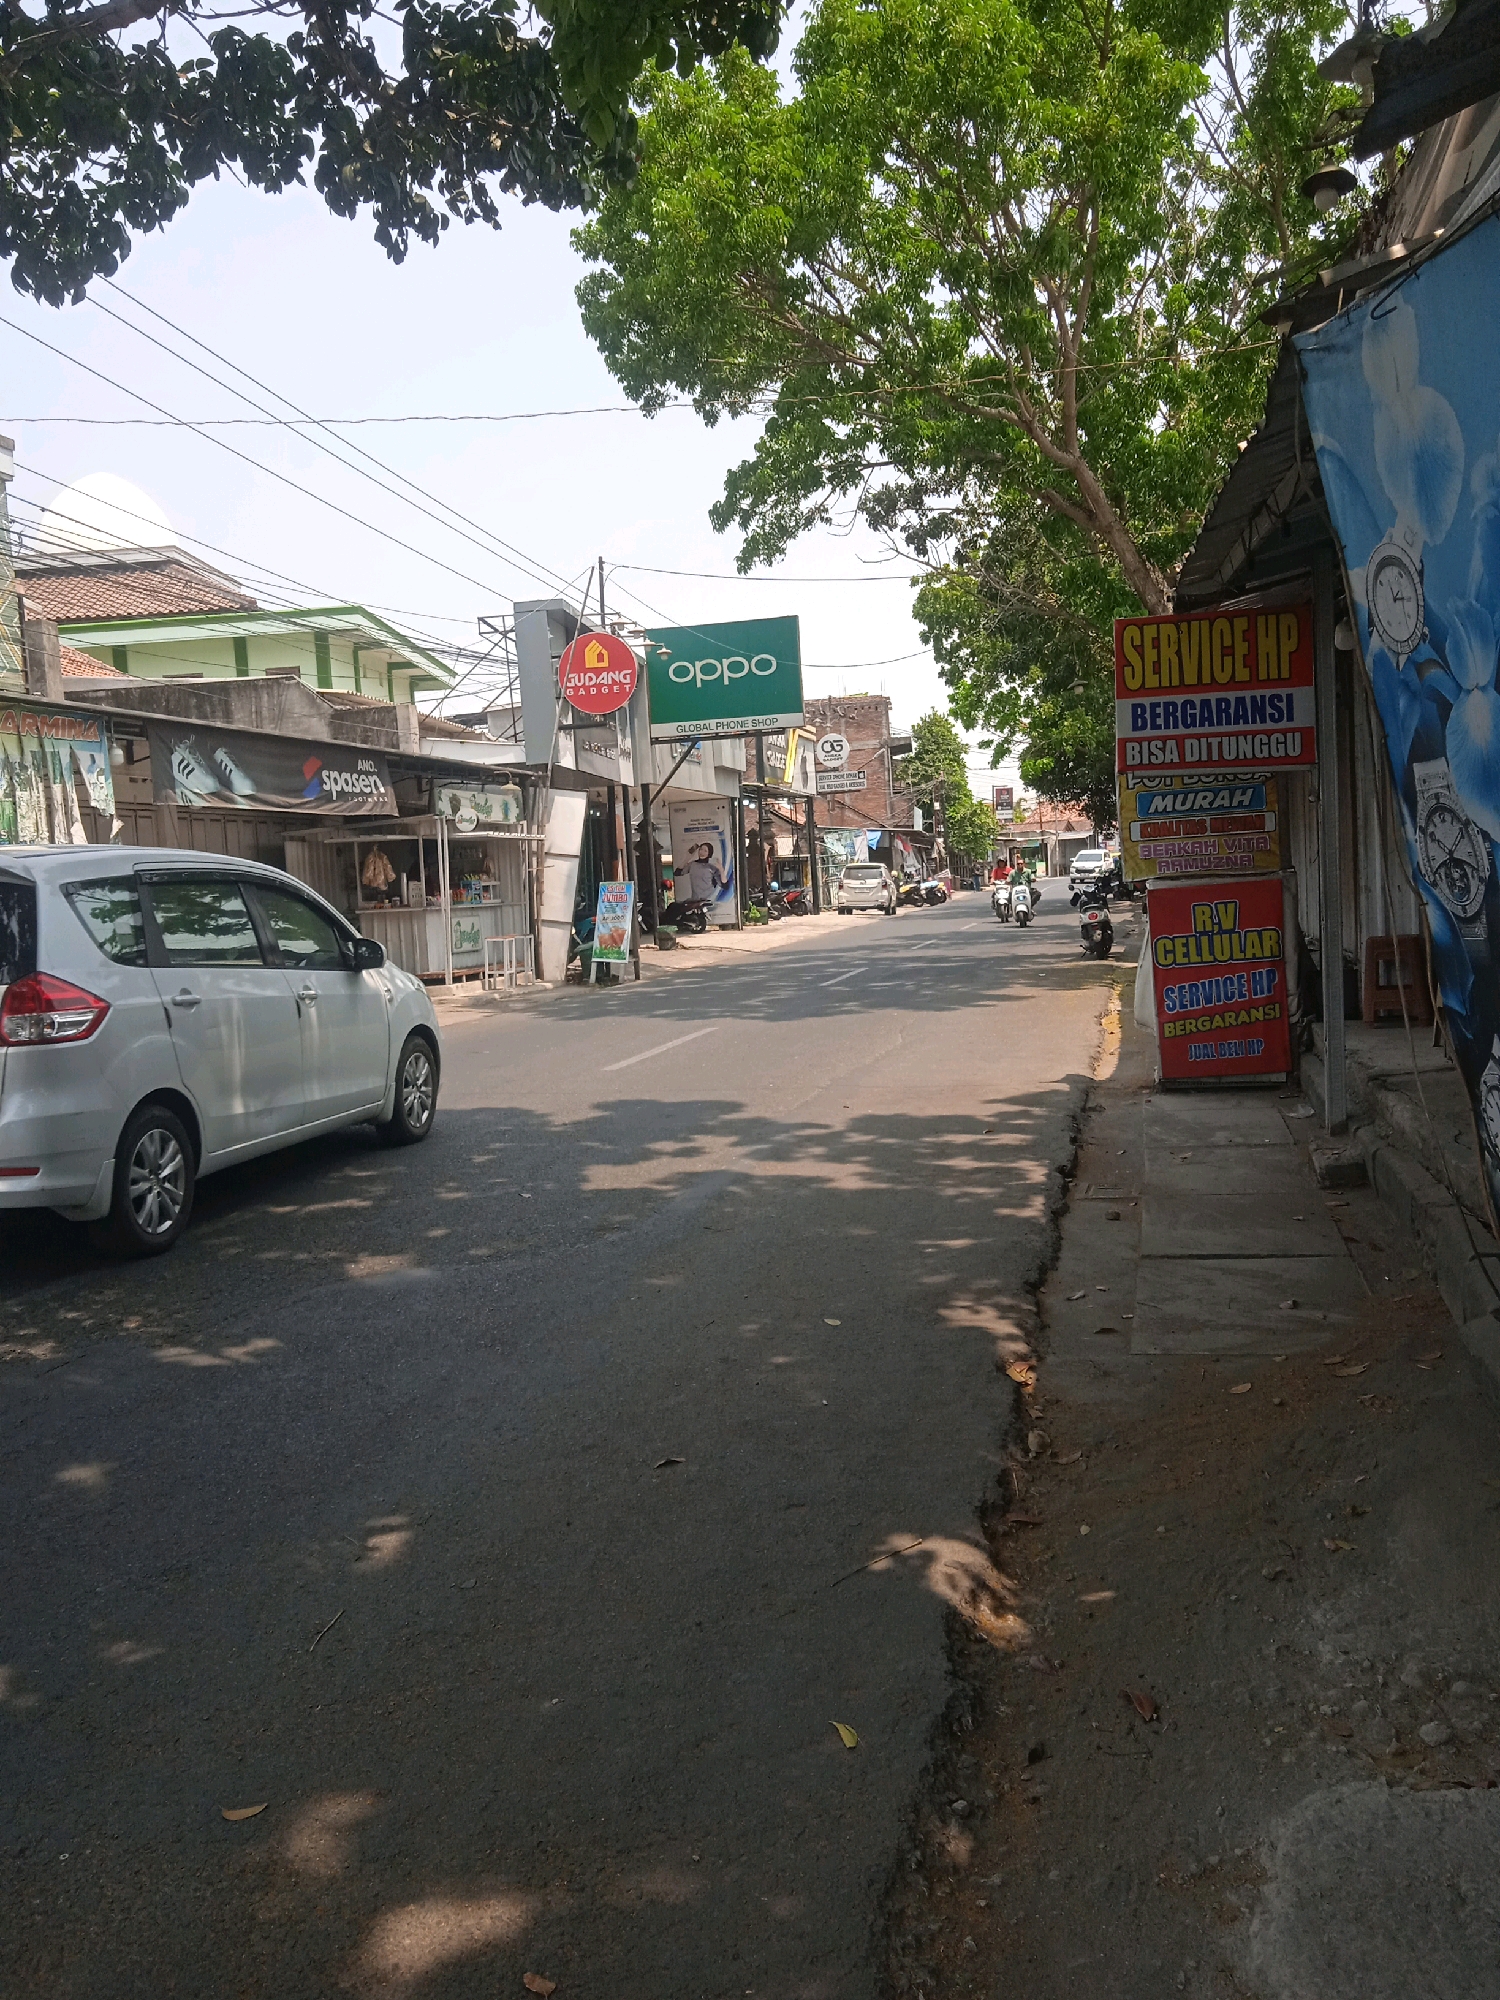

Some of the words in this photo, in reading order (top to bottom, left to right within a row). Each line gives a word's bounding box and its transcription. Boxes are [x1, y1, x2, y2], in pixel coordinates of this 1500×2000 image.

[1122, 616, 1250, 691] SERVICE
[1256, 612, 1299, 681] HP
[566, 669, 632, 688] GUDANG
[668, 653, 777, 688] oppo
[566, 684, 631, 696] GADGET
[676, 722, 714, 734] GLOBAL
[715, 720, 750, 731] PHONE
[751, 717, 779, 728] SHOP
[1131, 692, 1295, 733] BERGARANSI
[1125, 739, 1180, 766] BISA
[1184, 731, 1302, 764] DITUNGGU
[322, 769, 386, 800] spasen
[1148, 788, 1254, 815] MURAH
[1140, 818, 1208, 839] KUALITAS
[1139, 839, 1219, 859] BERKAH
[1223, 835, 1271, 853] VITA
[1157, 854, 1254, 874] ARMUZNA
[1155, 928, 1281, 967] CELLULAR
[1164, 973, 1249, 1013] SERVICE
[1251, 968, 1278, 998] HP
[1163, 1003, 1281, 1038] BERGARANSI
[1188, 1043, 1217, 1061] JUAL
[1218, 1040, 1246, 1059] BELI
[1247, 1038, 1264, 1056] HP
